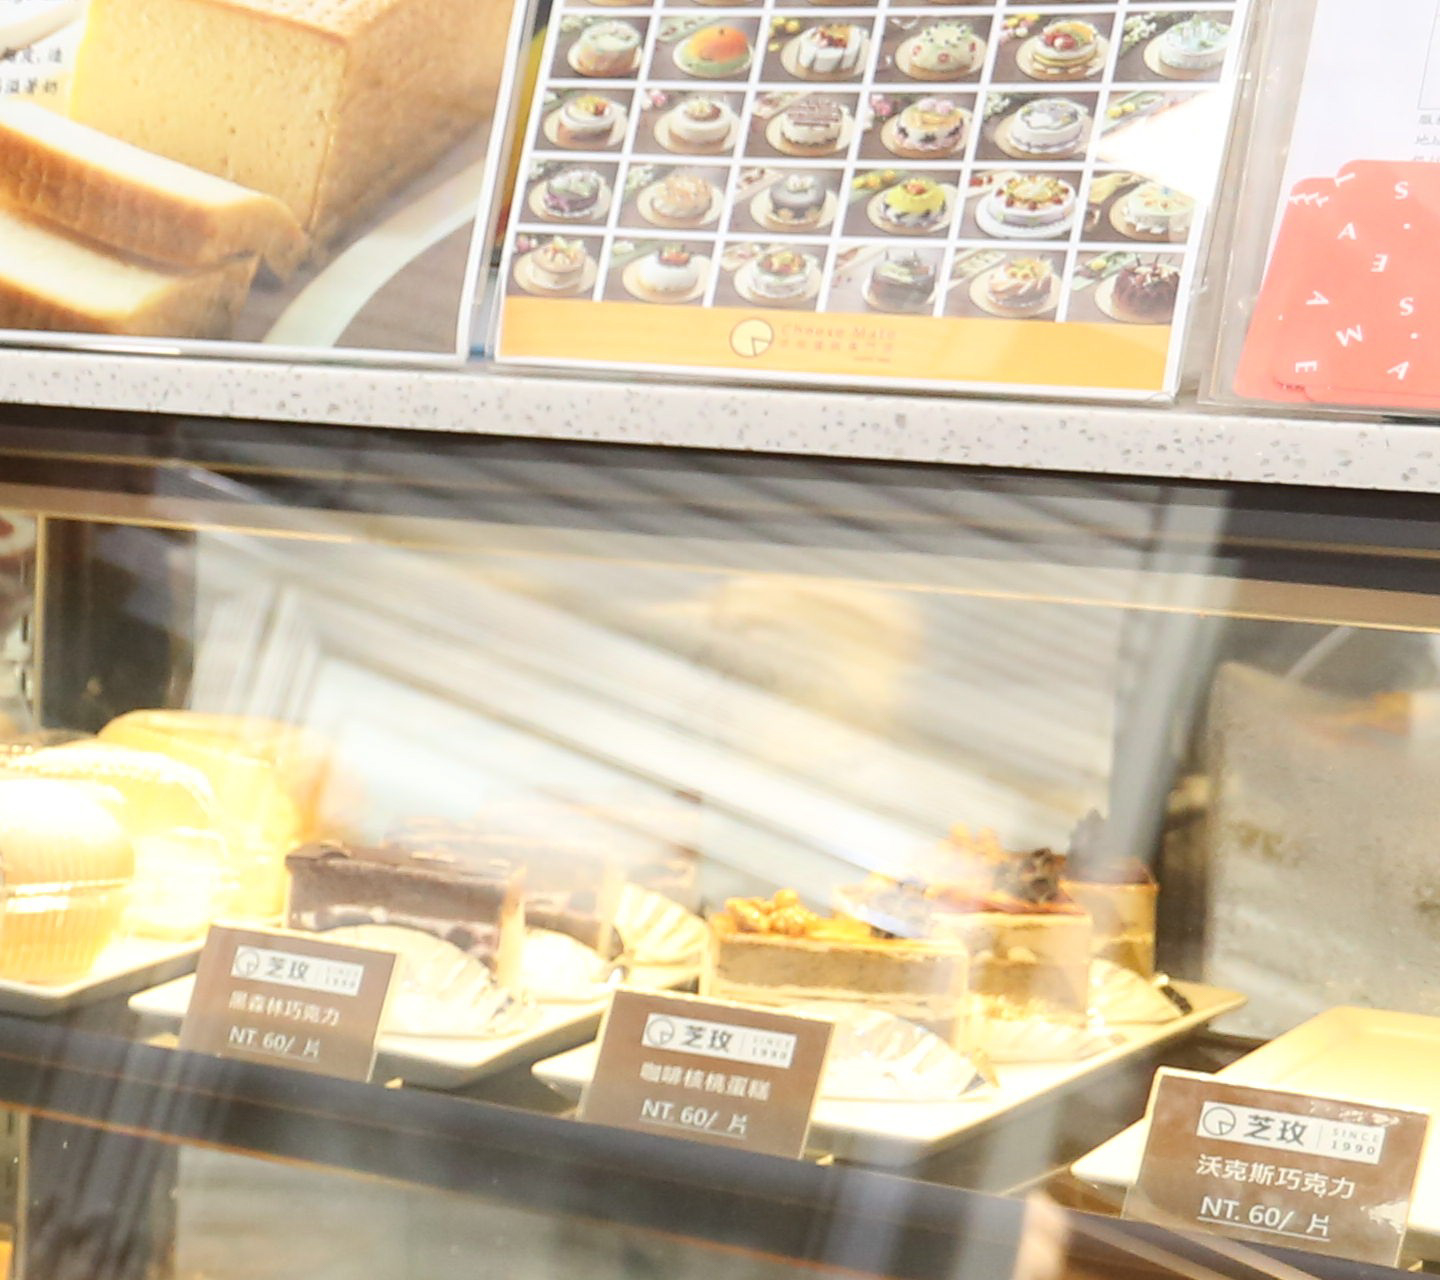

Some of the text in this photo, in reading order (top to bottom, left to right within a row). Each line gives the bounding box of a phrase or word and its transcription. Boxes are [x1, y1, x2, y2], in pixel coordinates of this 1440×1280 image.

[682, 1024, 734, 1053] 芝玫
[728, 1114, 748, 1135] 片
[1244, 1114, 1308, 1146] 芝玫
[1332, 1128, 1380, 1144] SINCE
[1331, 1141, 1376, 1157] 1990
[1195, 1153, 1356, 1200] 沃克斯巧克力
[1200, 1196, 1330, 1236] NT. 60/ 片
